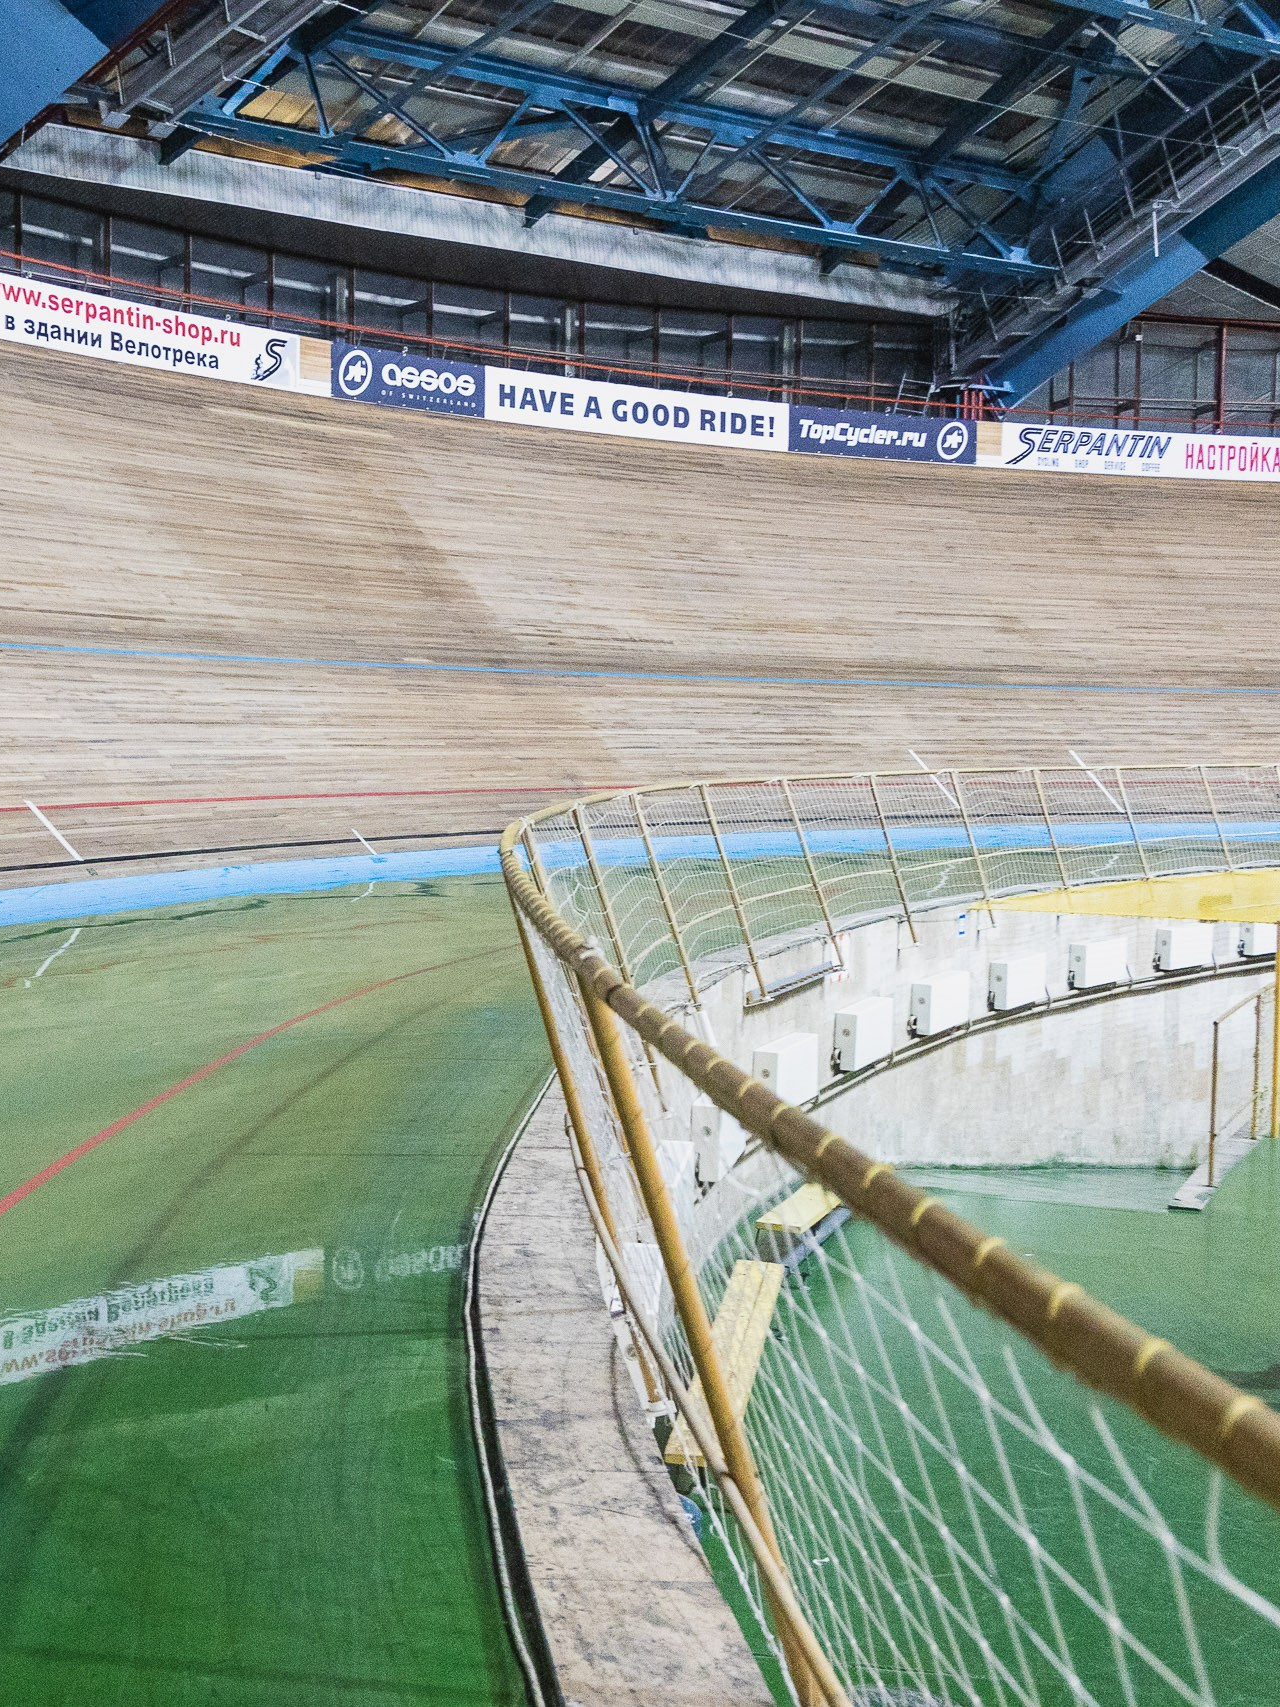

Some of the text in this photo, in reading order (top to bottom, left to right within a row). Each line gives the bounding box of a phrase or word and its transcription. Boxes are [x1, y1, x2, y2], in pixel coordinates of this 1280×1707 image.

[4, 314, 219, 370] в здании Велотрека
[381, 363, 476, 396] assos
[381, 389, 476, 408] OF SWITZERLAND
[498, 384, 775, 438] HAVE A GOOD RIDE!
[799, 418, 926, 449] TopCycler.ru
[1005, 427, 1172, 465] SERPANTIN
[1186, 442, 1280, 472] НАСТРОЙКА
